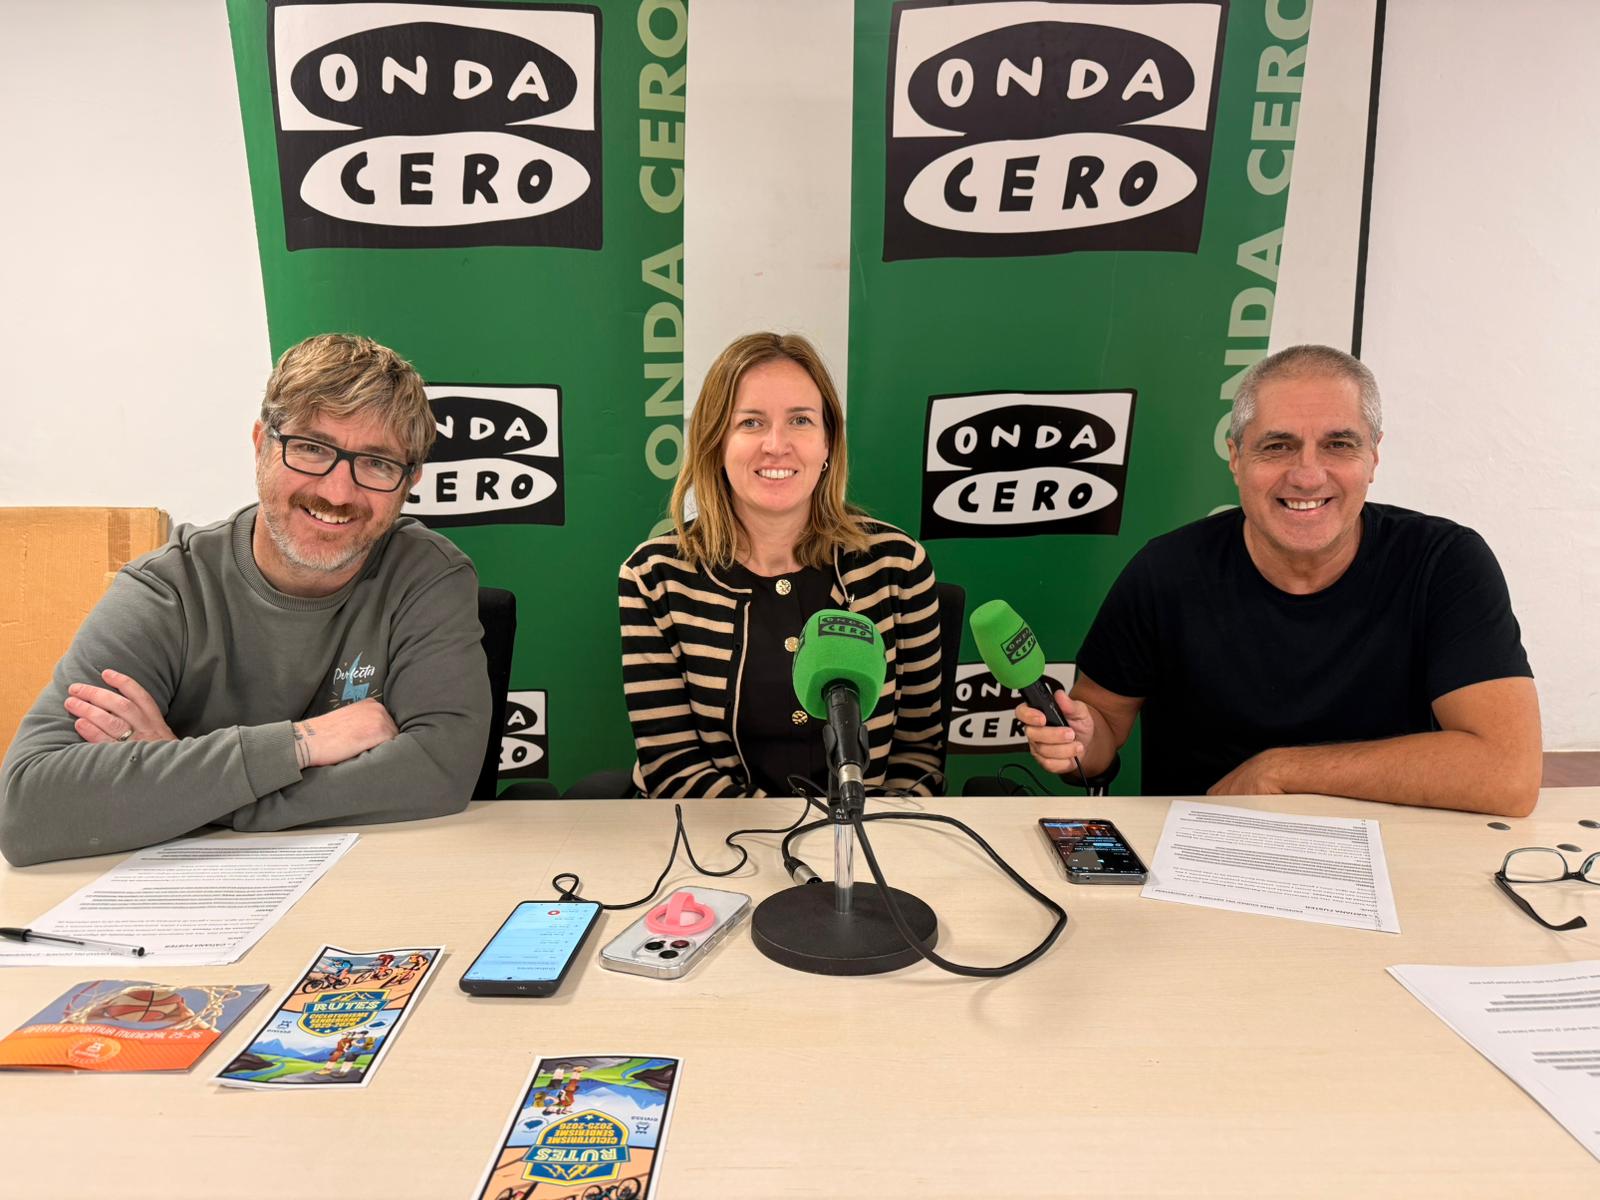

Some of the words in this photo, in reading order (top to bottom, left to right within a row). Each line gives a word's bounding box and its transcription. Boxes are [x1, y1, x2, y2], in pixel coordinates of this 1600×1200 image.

[319, 53, 549, 102] ONDA
[937, 56, 1165, 108] ONDA
[637, 0, 688, 213] CERO
[340, 151, 553, 205] CERO
[944, 155, 1158, 213] CERO
[641, 248, 685, 481] ONDA
[436, 415, 531, 441] NDA
[954, 424, 1098, 455] ONDA
[958, 480, 1093, 513] CERO
[828, 625, 867, 636] CERO
[956, 682, 1022, 702] ON
[959, 717, 1026, 739] CER
[313, 1000, 381, 1012] RUTES
[168, 1031, 203, 1039] 25-26
[554, 1129, 615, 1137] SENDERISME
[559, 1122, 614, 1130] 2025-2026
[546, 1136, 618, 1145] CICLOTURISME
[534, 1147, 618, 1162] RUTES
